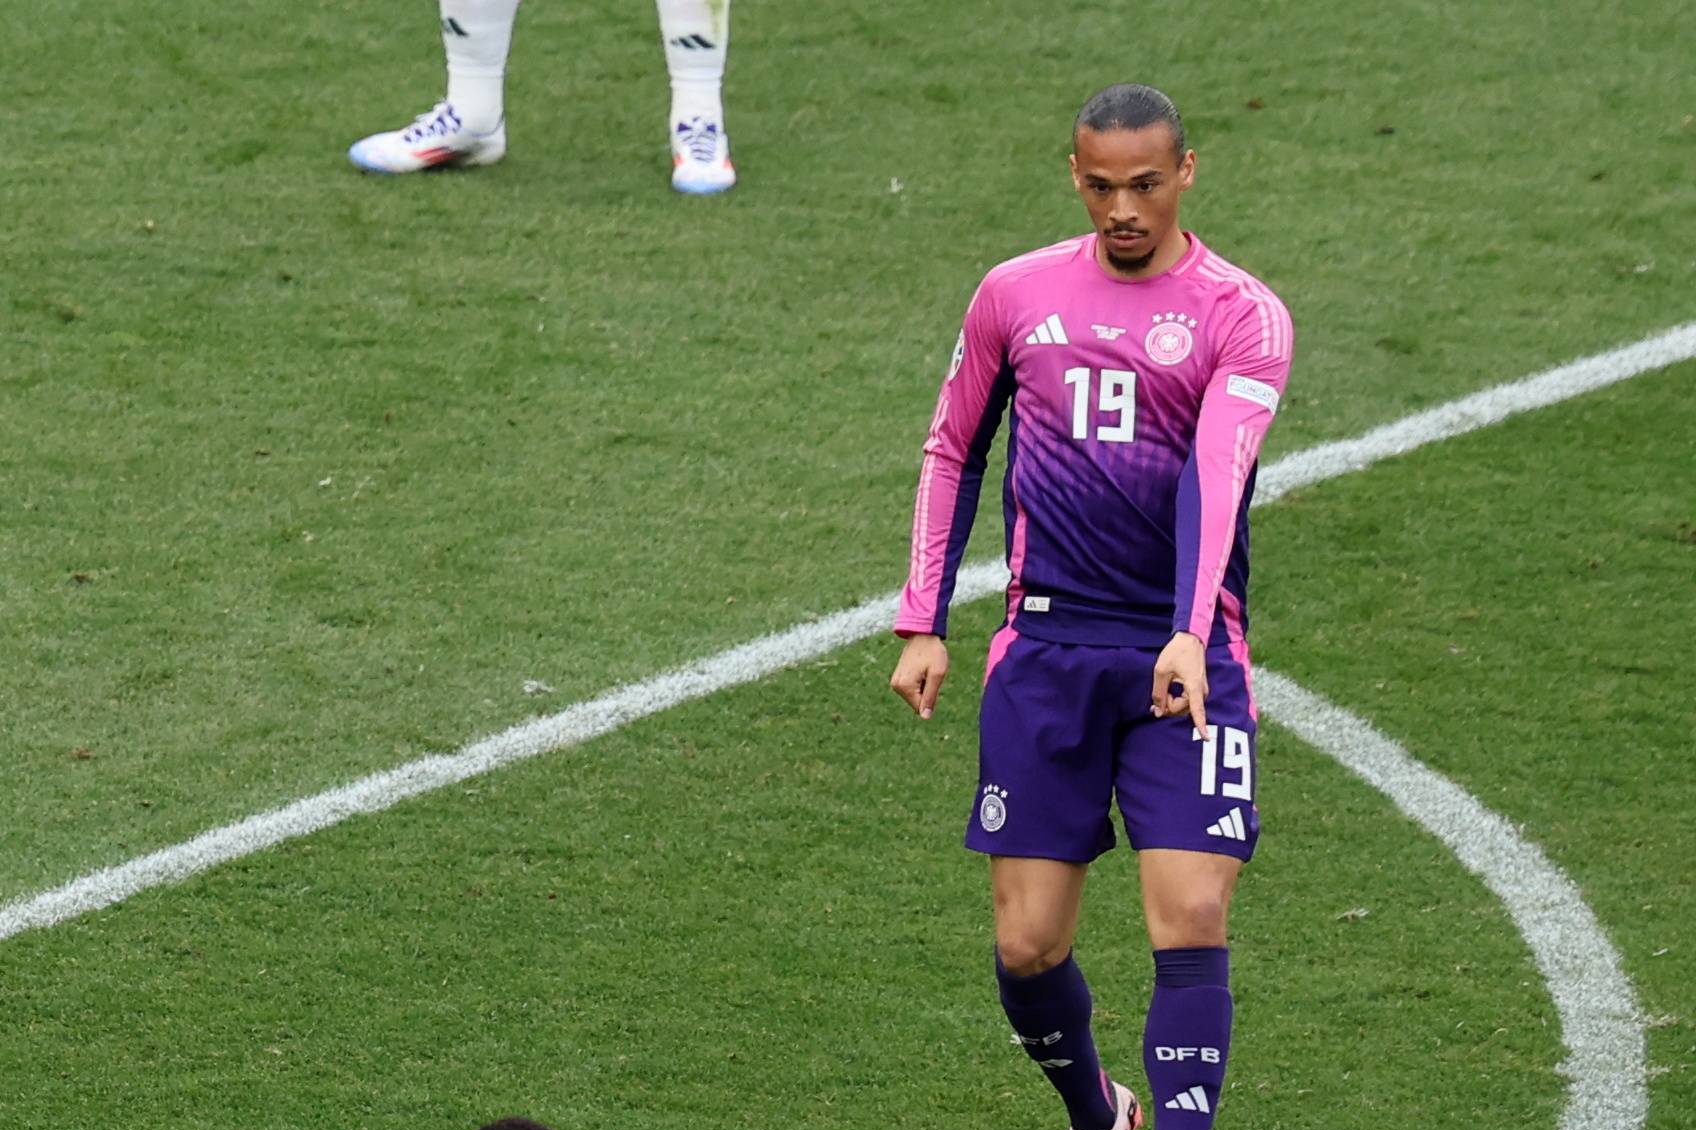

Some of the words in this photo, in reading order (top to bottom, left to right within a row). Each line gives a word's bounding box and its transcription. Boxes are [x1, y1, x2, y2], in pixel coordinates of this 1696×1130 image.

[1064, 367, 1136, 442] 19
[1192, 724, 1252, 801] 19
[1155, 1046, 1221, 1064] DFB
